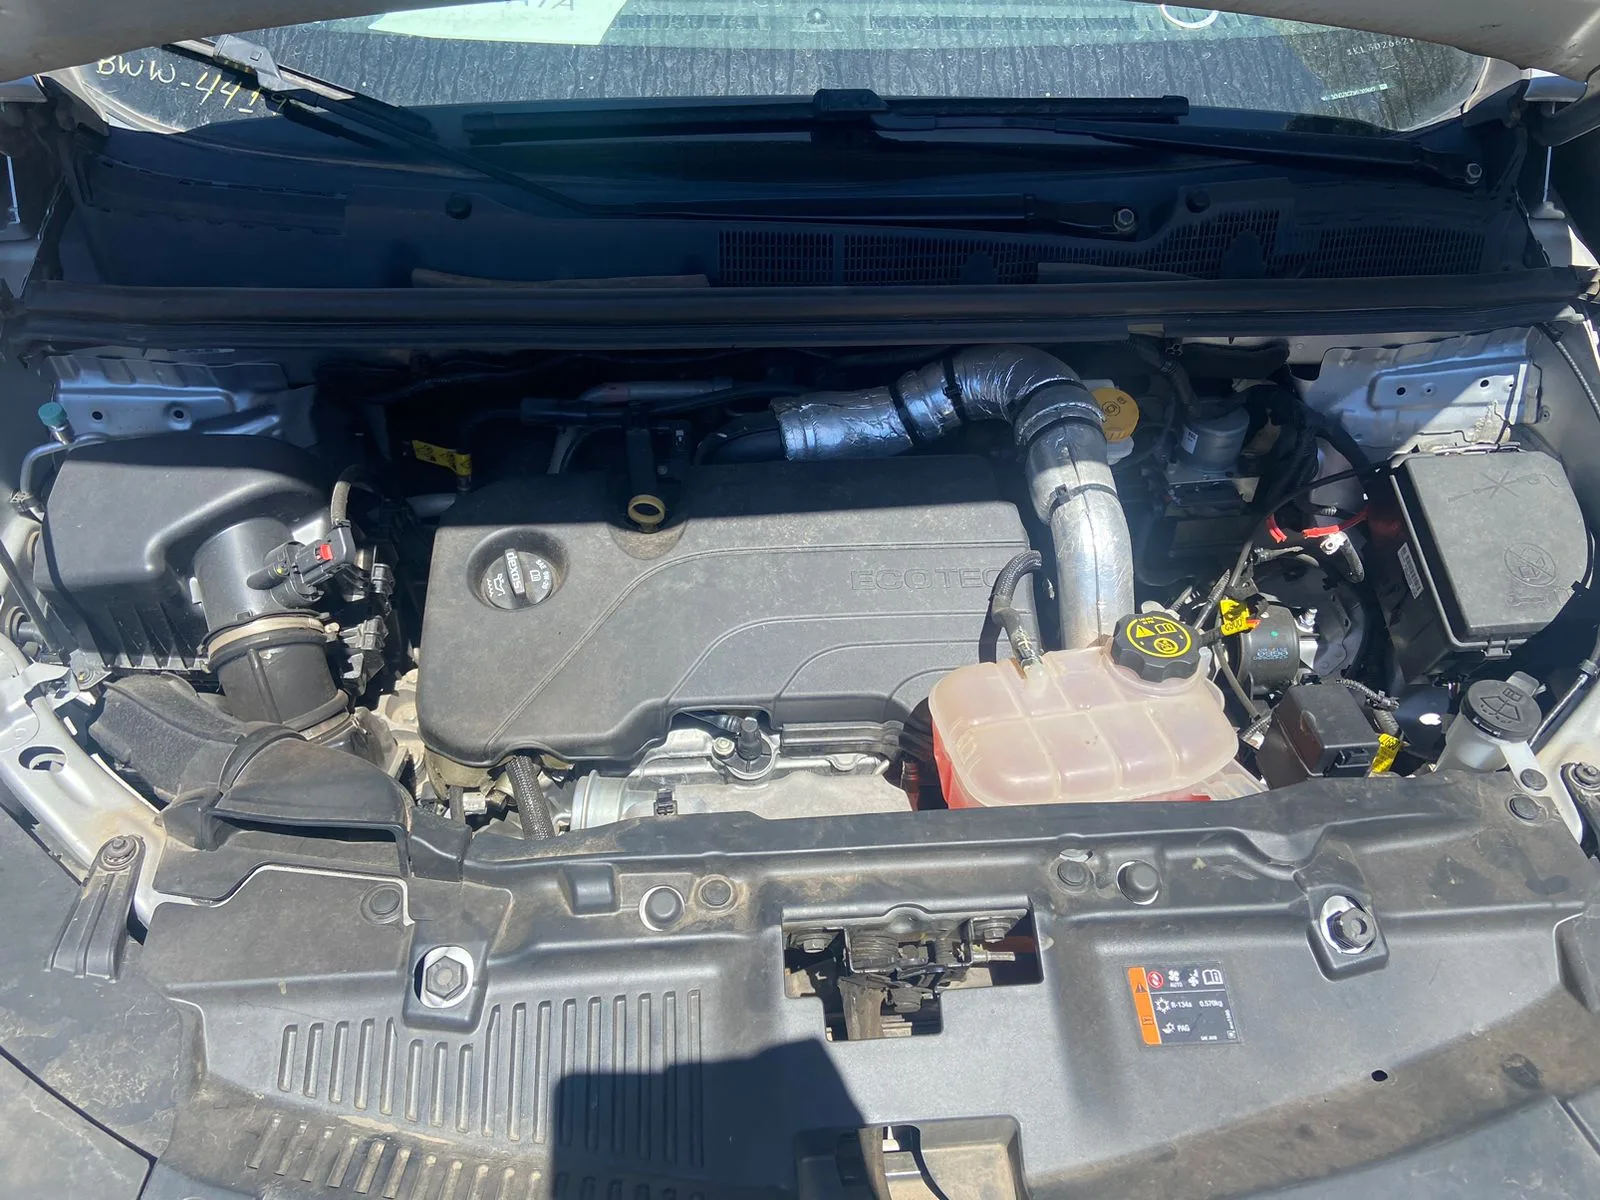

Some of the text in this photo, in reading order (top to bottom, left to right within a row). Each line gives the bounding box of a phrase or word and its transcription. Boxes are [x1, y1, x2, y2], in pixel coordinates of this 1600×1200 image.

[506, 552, 523, 591] dexos
[535, 559, 547, 570] SAE
[850, 567, 1001, 591] ECOTEC
[1177, 1024, 1190, 1032] PAG
